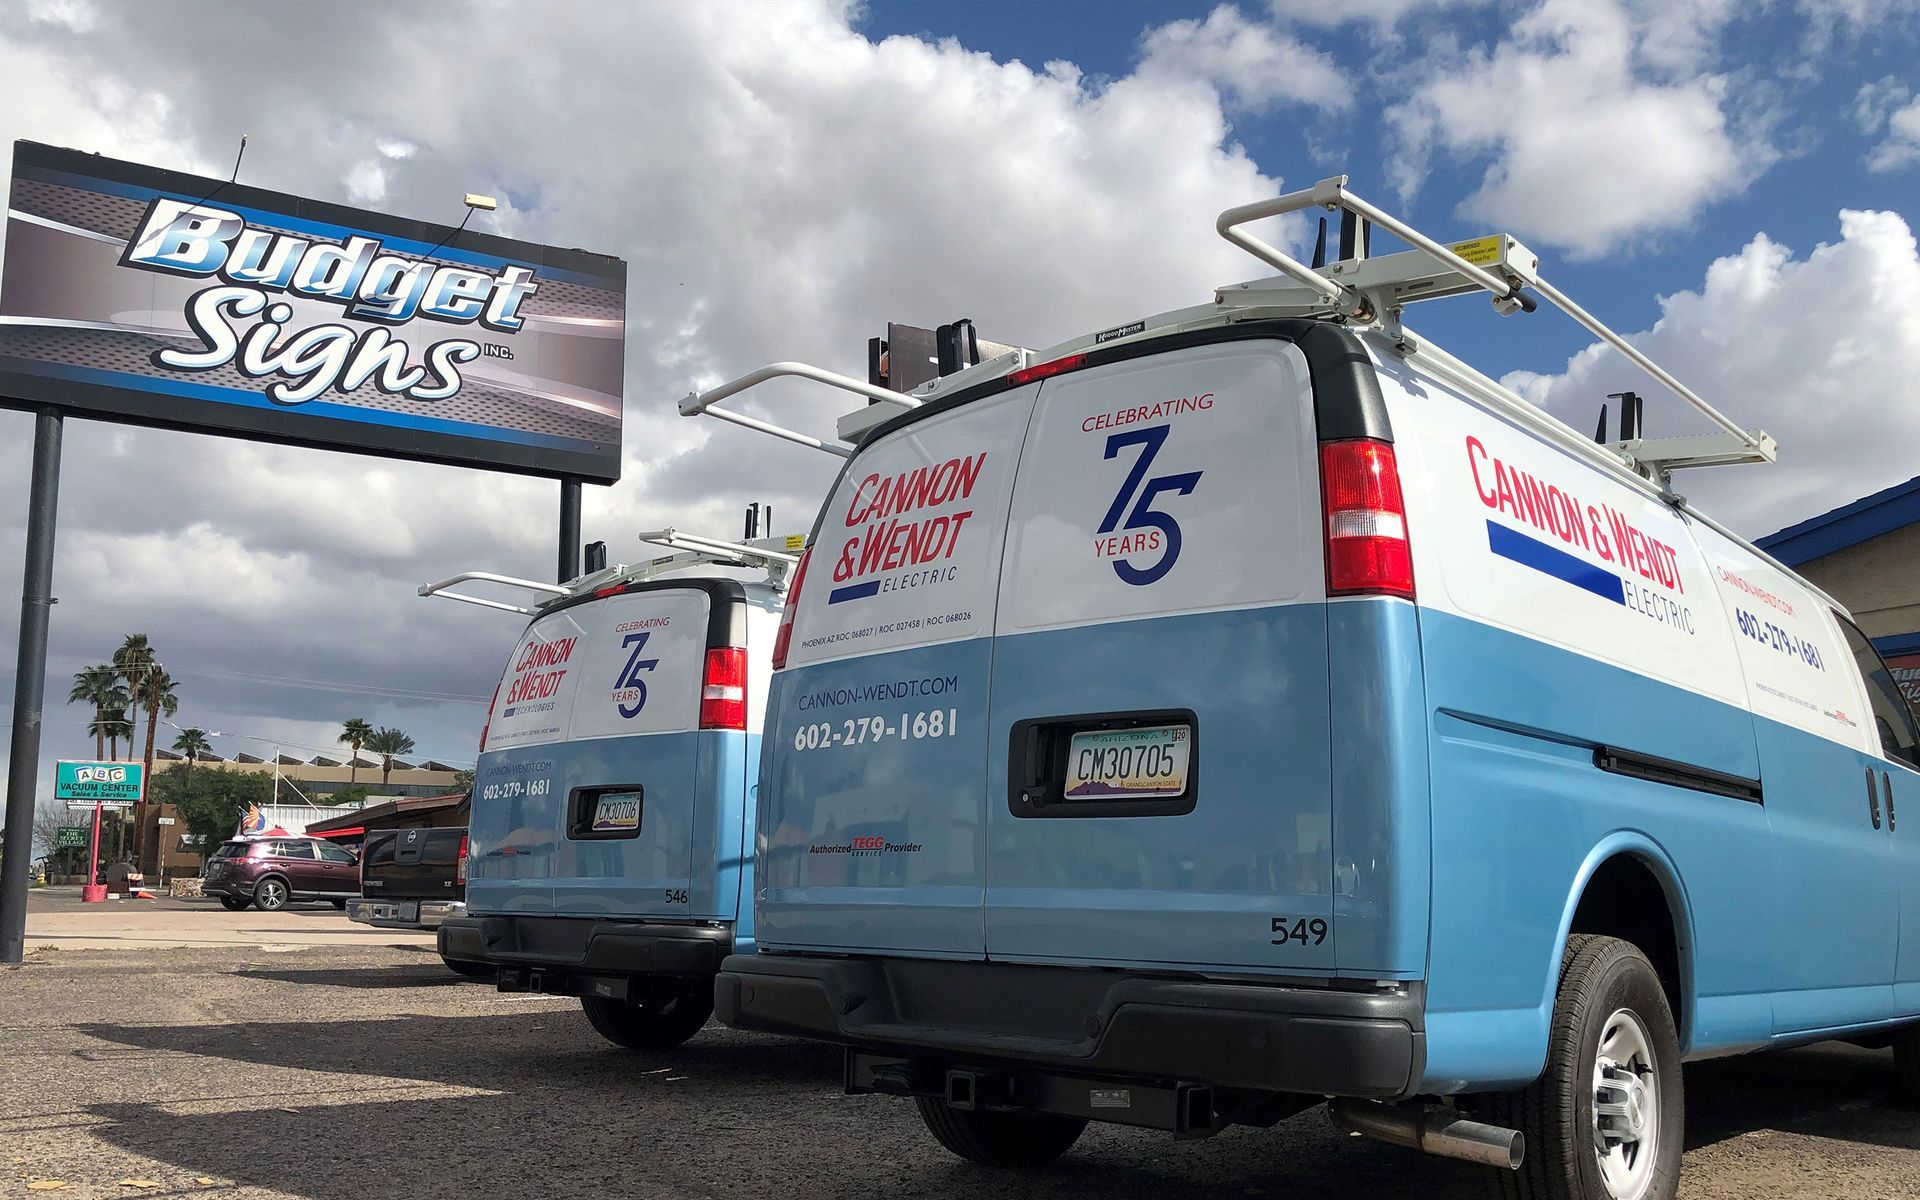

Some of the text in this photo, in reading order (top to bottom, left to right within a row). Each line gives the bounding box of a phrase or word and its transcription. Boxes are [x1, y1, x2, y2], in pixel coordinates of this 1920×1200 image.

[120, 197, 540, 331] Budget
[155, 287, 514, 405] Signs INC.
[1082, 394, 1214, 432] CELEBRATING
[844, 452, 987, 528] CANNON
[1096, 424, 1204, 586] 75
[1466, 435, 1684, 594] CANNON & WENDT
[1094, 531, 1160, 558] YEARS
[882, 566, 957, 593] ELECTRIC
[616, 616, 670, 633] CELEBRATING
[1625, 580, 1695, 636] ELECTRIC
[801, 638, 826, 648] PHOENIX
[836, 632, 850, 642] ROC
[851, 628, 873, 638] 068027
[879, 623, 894, 634] ROC
[896, 620, 920, 631] 027458
[926, 615, 944, 626] ROC
[945, 612, 972, 624] 068026
[1736, 606, 1826, 672] 602-279-1681
[516, 636, 578, 673] CANNON
[613, 632, 660, 719] 75
[798, 675, 958, 711] CANNON-WENDT.COM
[612, 690, 639, 702] YEARS
[794, 708, 957, 751] 602-279-1681
[1100, 733, 1159, 743] ARIZONA
[1077, 743, 1175, 780] CM30705
[60, 783, 138, 792] VACUUM CENTER
[484, 778, 550, 800] 602-279-1681
[599, 801, 637, 820] CM30706
[810, 836, 922, 854] Authorized TEGG Provider
[666, 890, 688, 904] 546
[1271, 918, 1328, 946] 549
